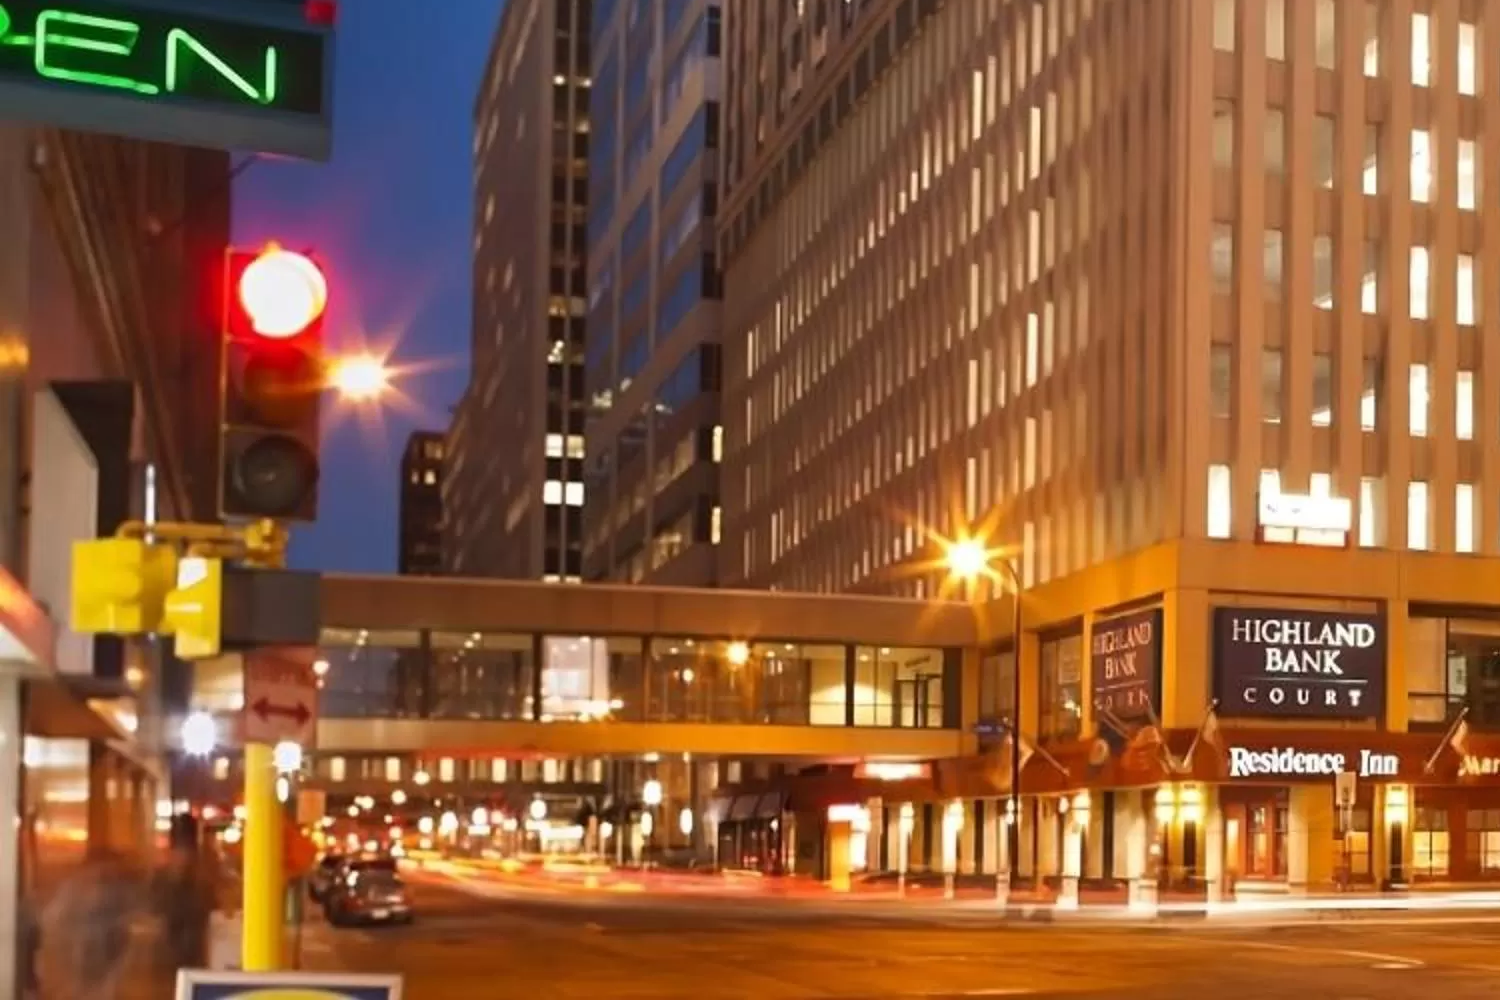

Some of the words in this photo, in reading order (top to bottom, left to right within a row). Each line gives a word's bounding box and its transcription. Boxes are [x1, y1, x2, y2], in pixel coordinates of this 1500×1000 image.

[0, 8, 276, 103] EN
[1231, 618, 1376, 648] HIGHLAND
[1265, 647, 1344, 675] BANK
[1243, 686, 1363, 708] COURT
[1229, 747, 1345, 777] Residence
[1359, 749, 1399, 777] Inn
